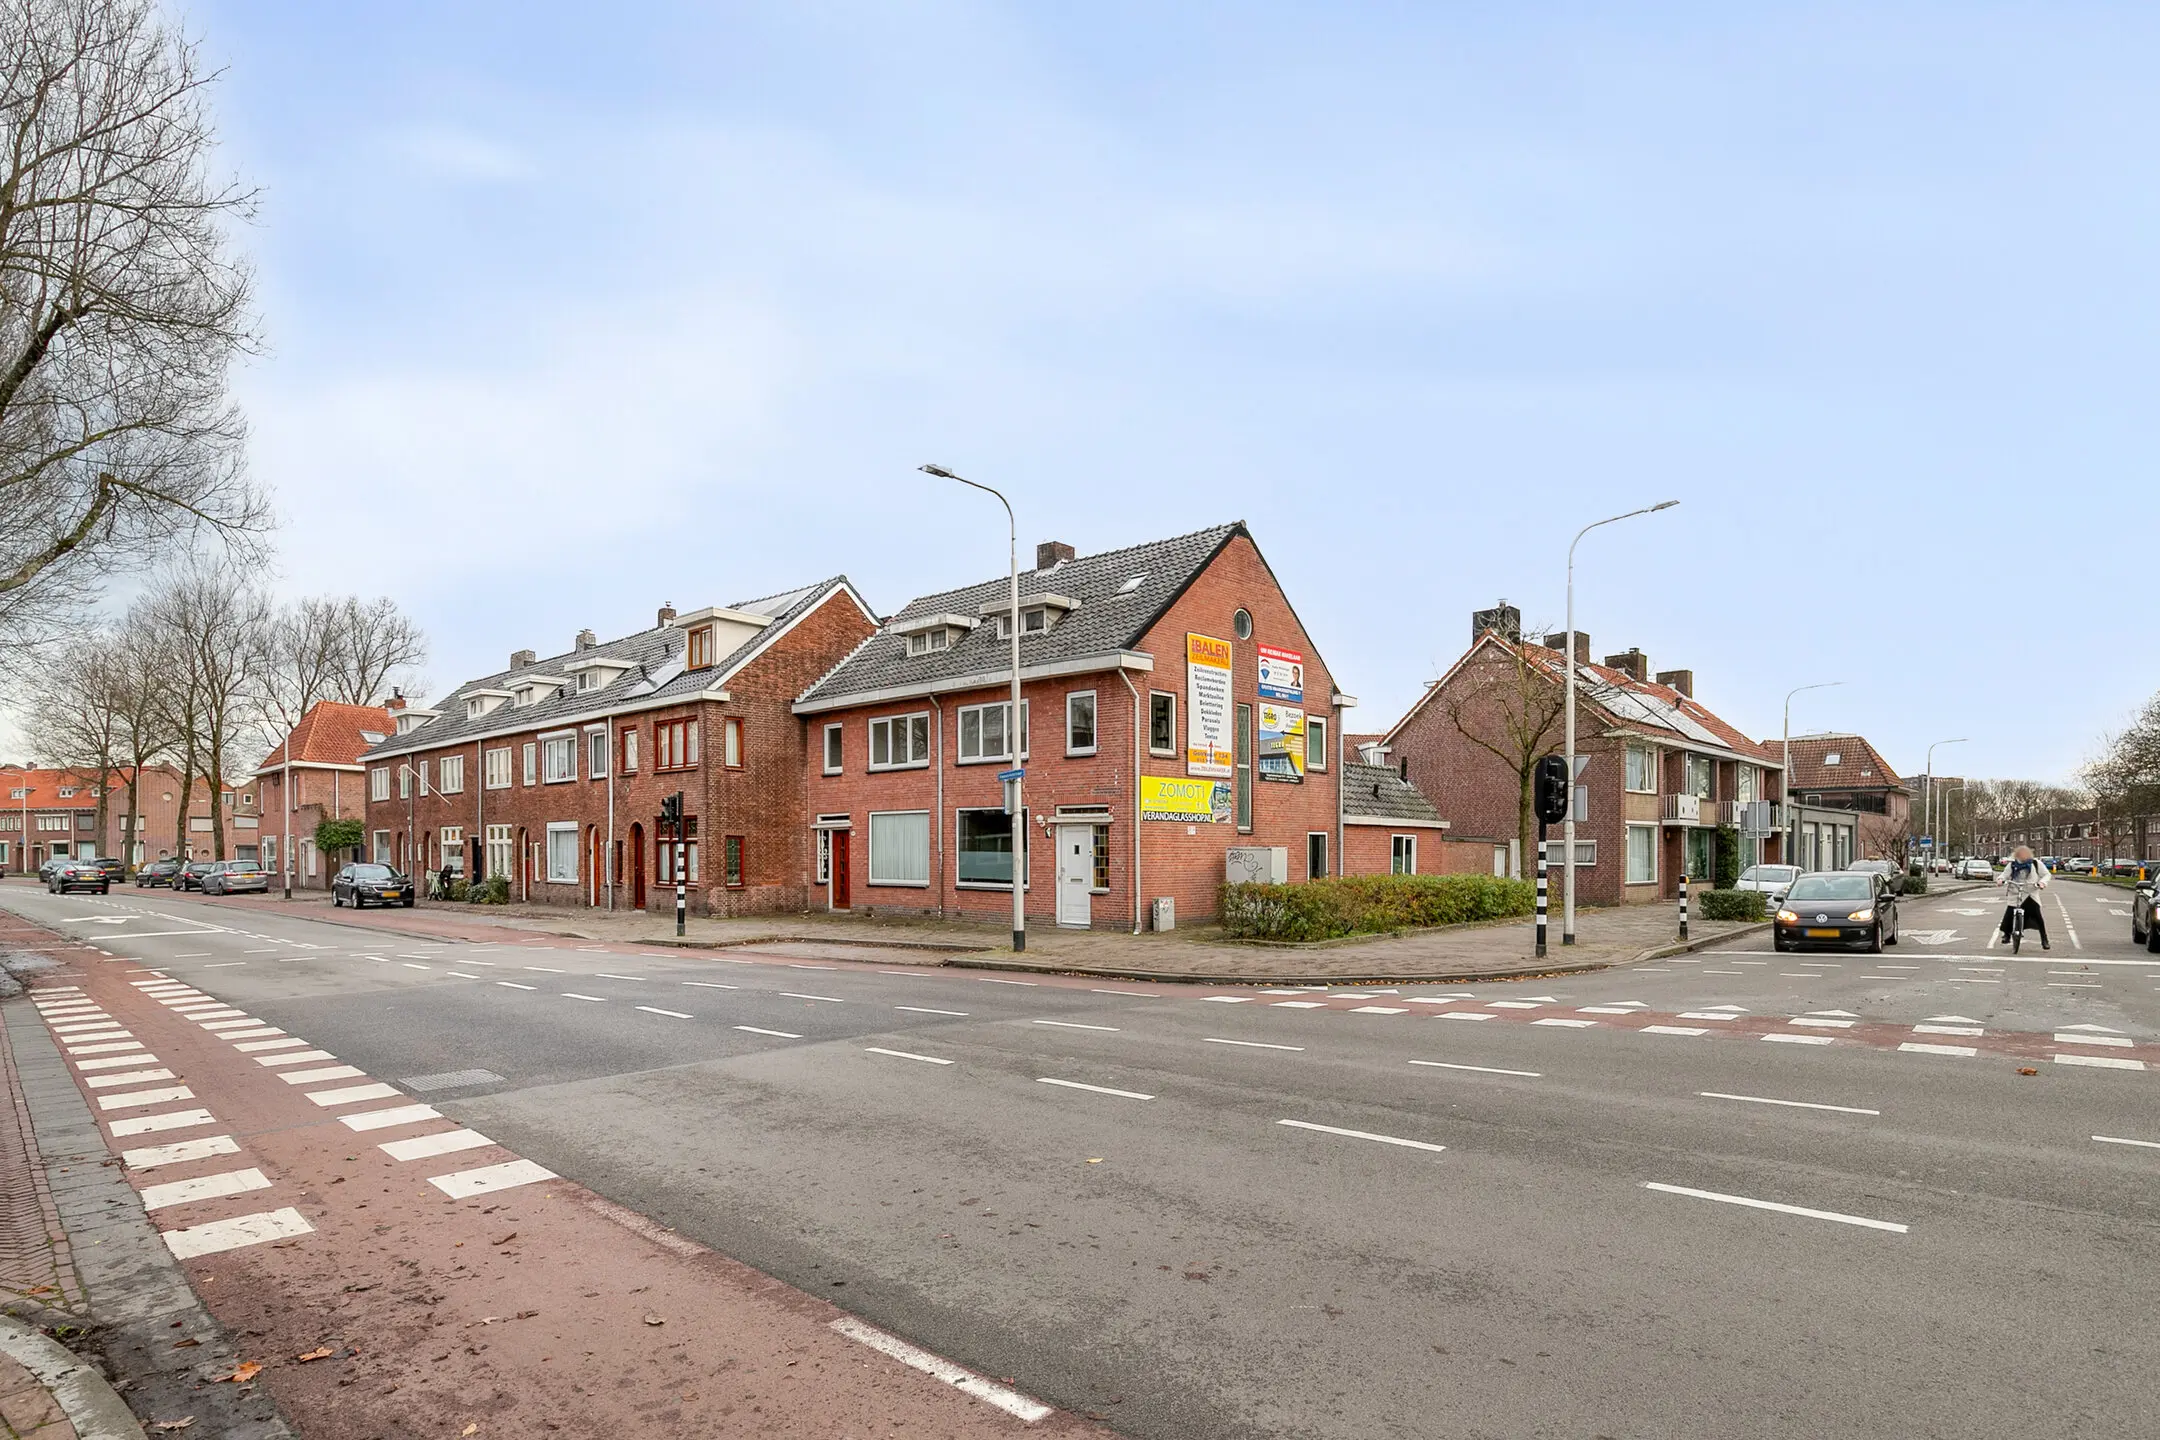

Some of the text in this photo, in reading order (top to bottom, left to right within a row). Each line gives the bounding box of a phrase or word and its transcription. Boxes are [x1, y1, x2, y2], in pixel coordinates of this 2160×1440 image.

[1195, 640, 1229, 659] BALEN
[1196, 683, 1224, 693] Spandoeken
[1143, 811, 1213, 823] VERANDAGLASSHOP.NL
